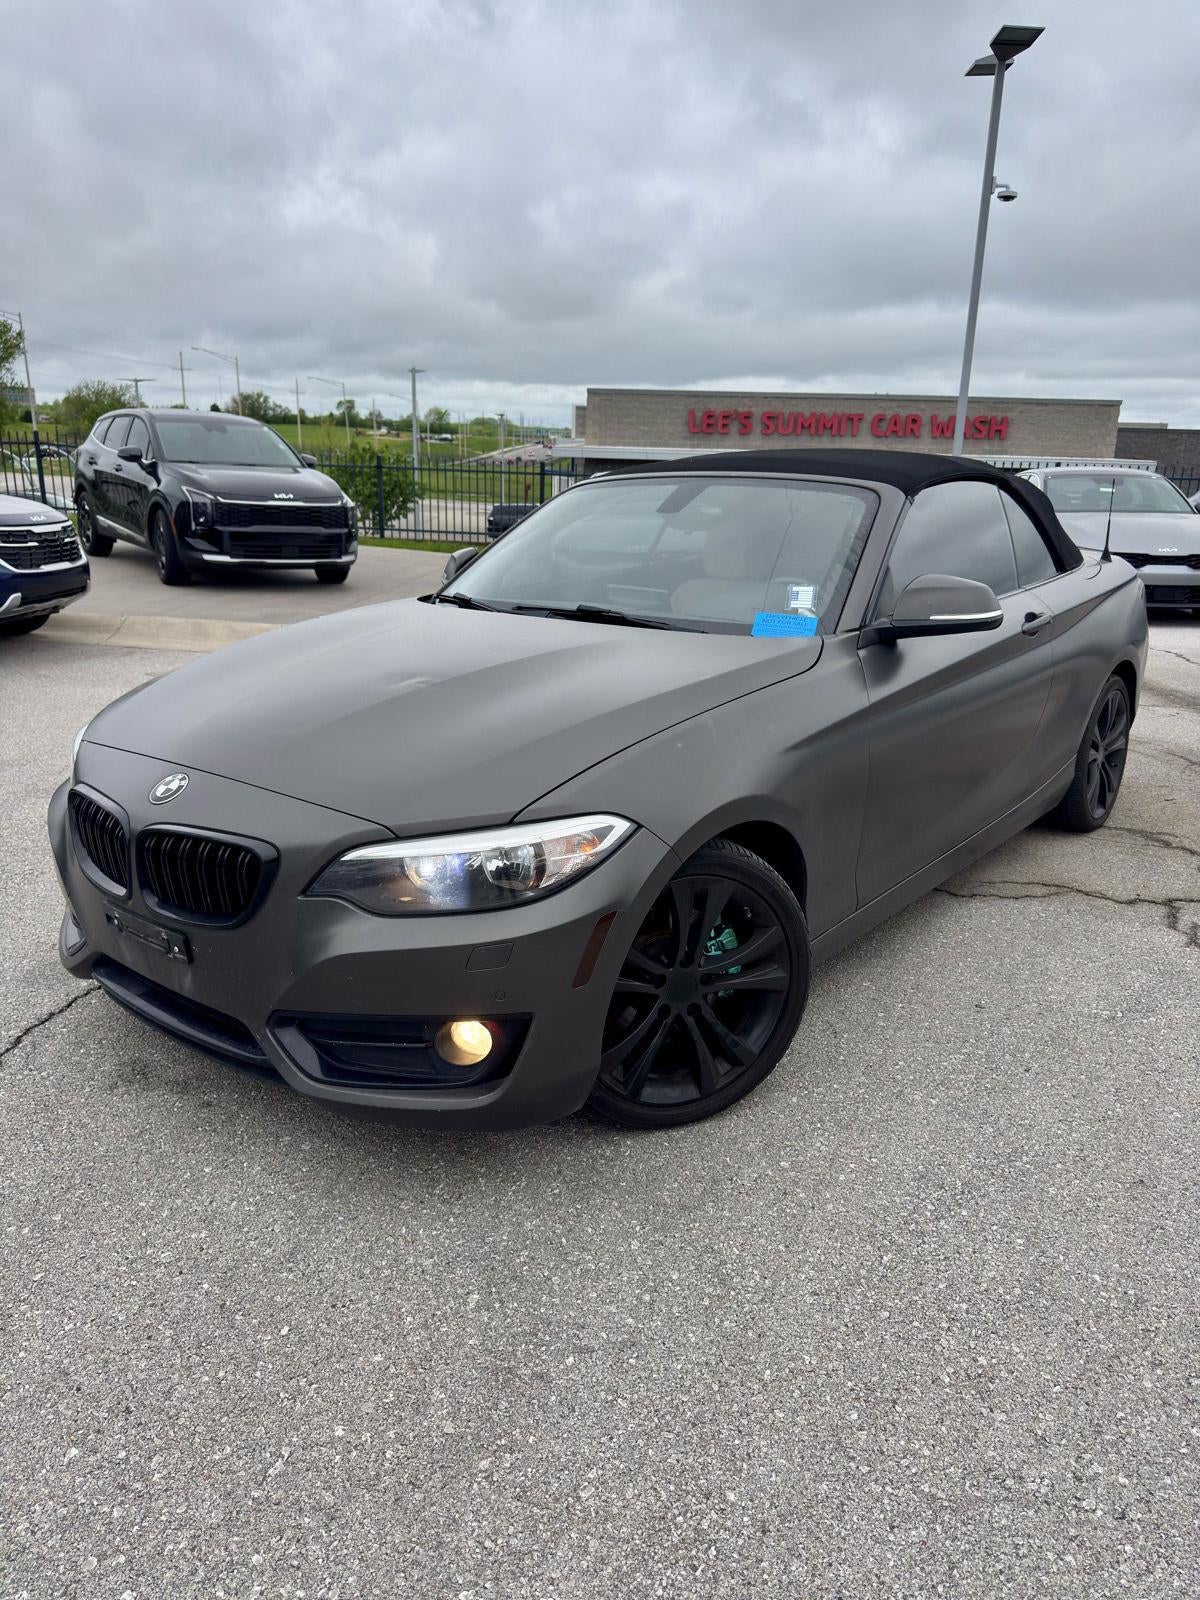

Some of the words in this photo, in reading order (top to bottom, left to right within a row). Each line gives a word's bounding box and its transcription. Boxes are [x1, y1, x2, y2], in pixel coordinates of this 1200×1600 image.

[688, 409, 753, 436] LEE'S
[761, 411, 865, 437] SUMMIT
[870, 413, 923, 438] CAR
